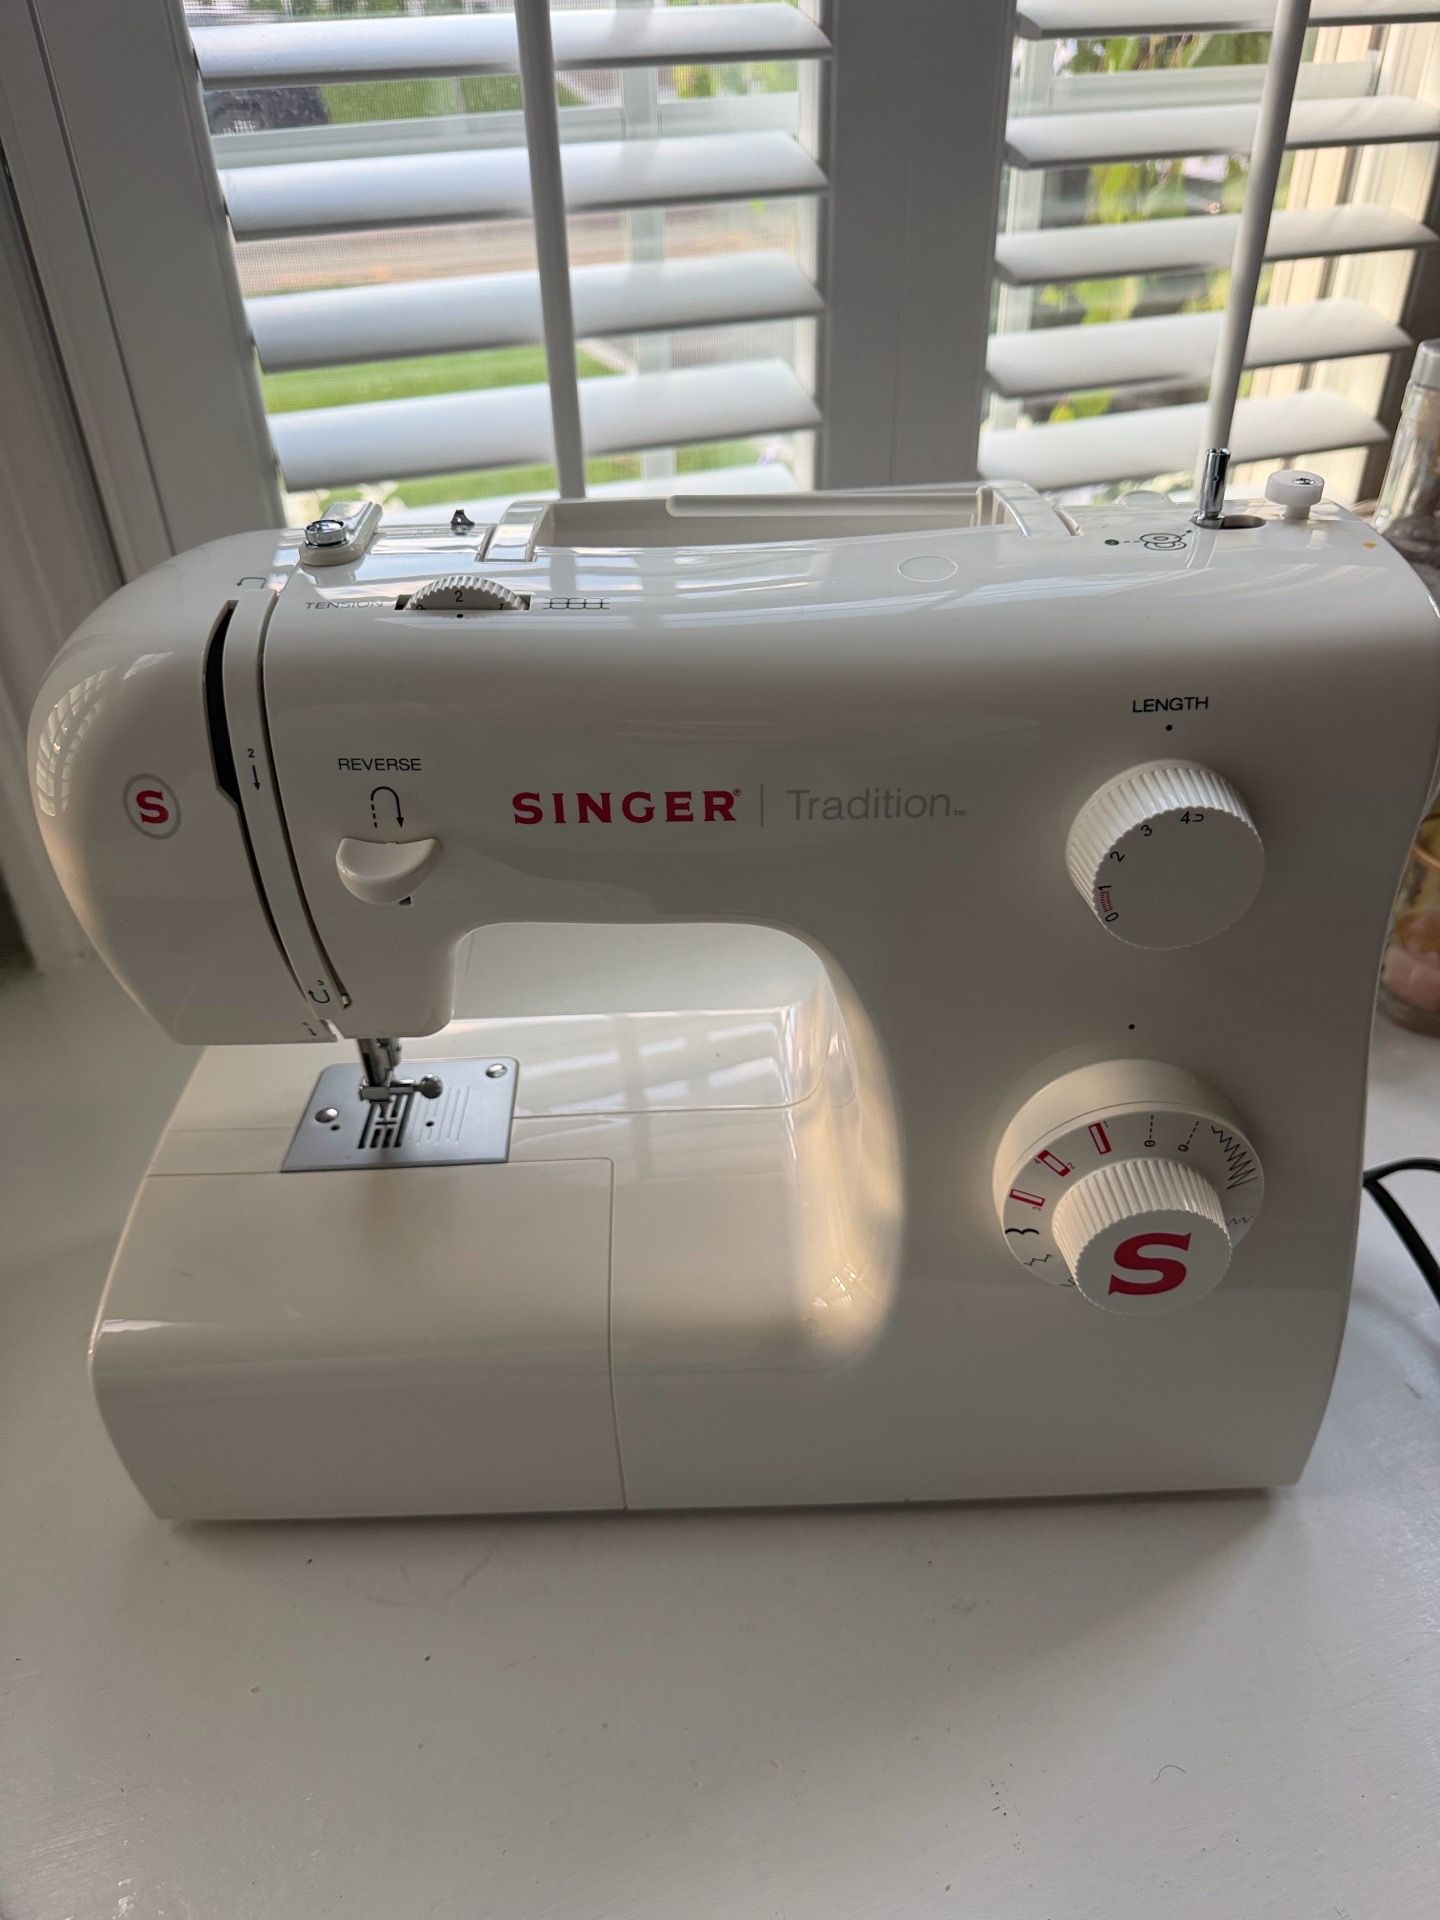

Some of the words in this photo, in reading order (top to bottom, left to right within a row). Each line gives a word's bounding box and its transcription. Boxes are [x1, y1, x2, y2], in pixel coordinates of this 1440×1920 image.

[455, 590, 464, 603] 2
[305, 600, 384, 610] TENSION
[1132, 696, 1209, 713] LENGTH
[247, 748, 255, 758] 2
[338, 757, 422, 772] REVERSE
[136, 790, 169, 824] S
[1180, 811, 1191, 824] 4
[1141, 824, 1152, 837] 3
[1110, 851, 1125, 862] 2
[1105, 912, 1119, 922] 0
[1108, 1232, 1191, 1295] S
